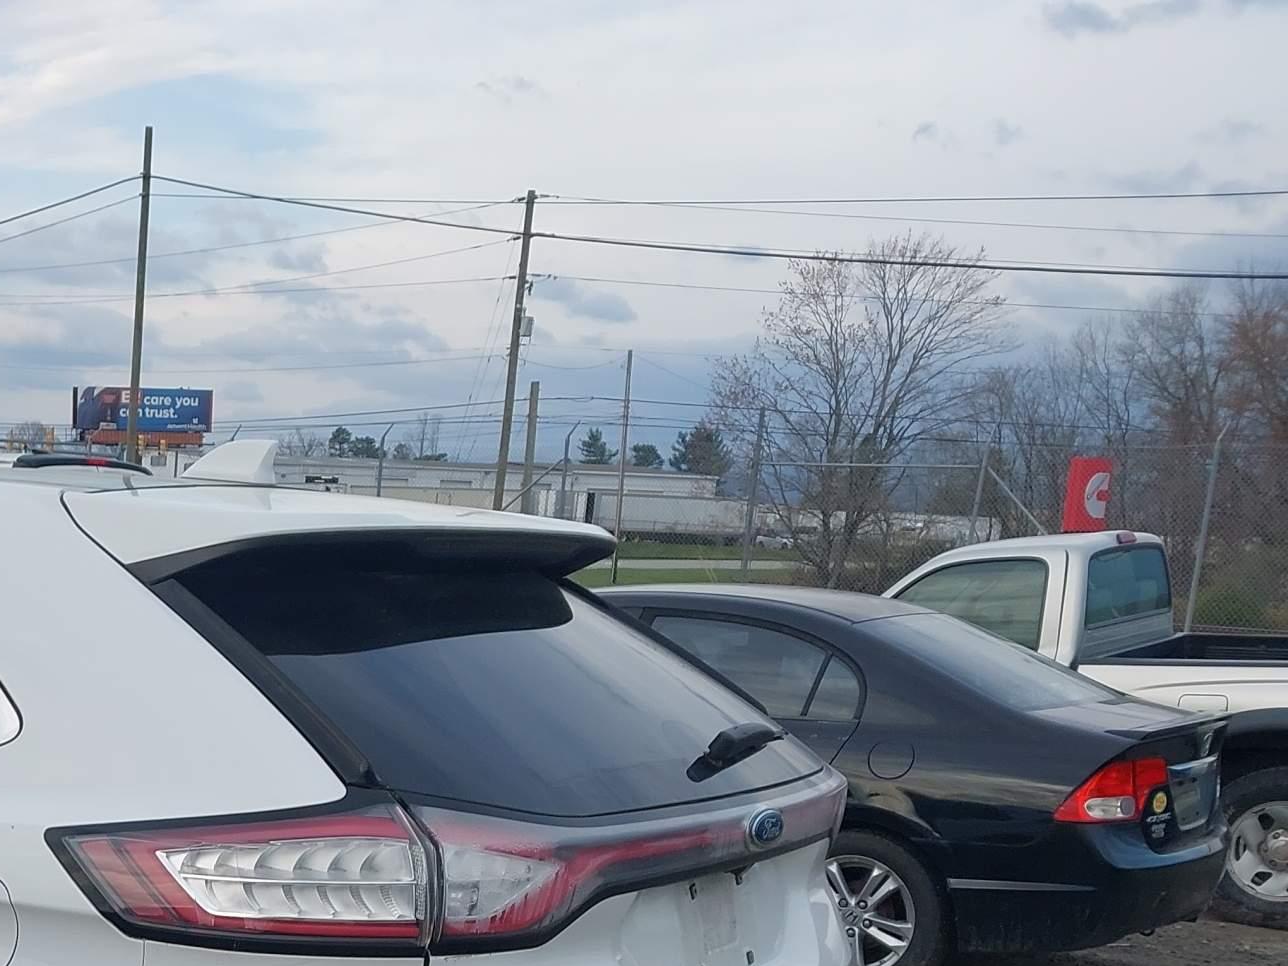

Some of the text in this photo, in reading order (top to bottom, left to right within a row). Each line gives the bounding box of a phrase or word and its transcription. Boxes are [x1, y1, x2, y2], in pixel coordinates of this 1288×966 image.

[121, 390, 199, 409] E care you
[144, 407, 178, 418] trust.
